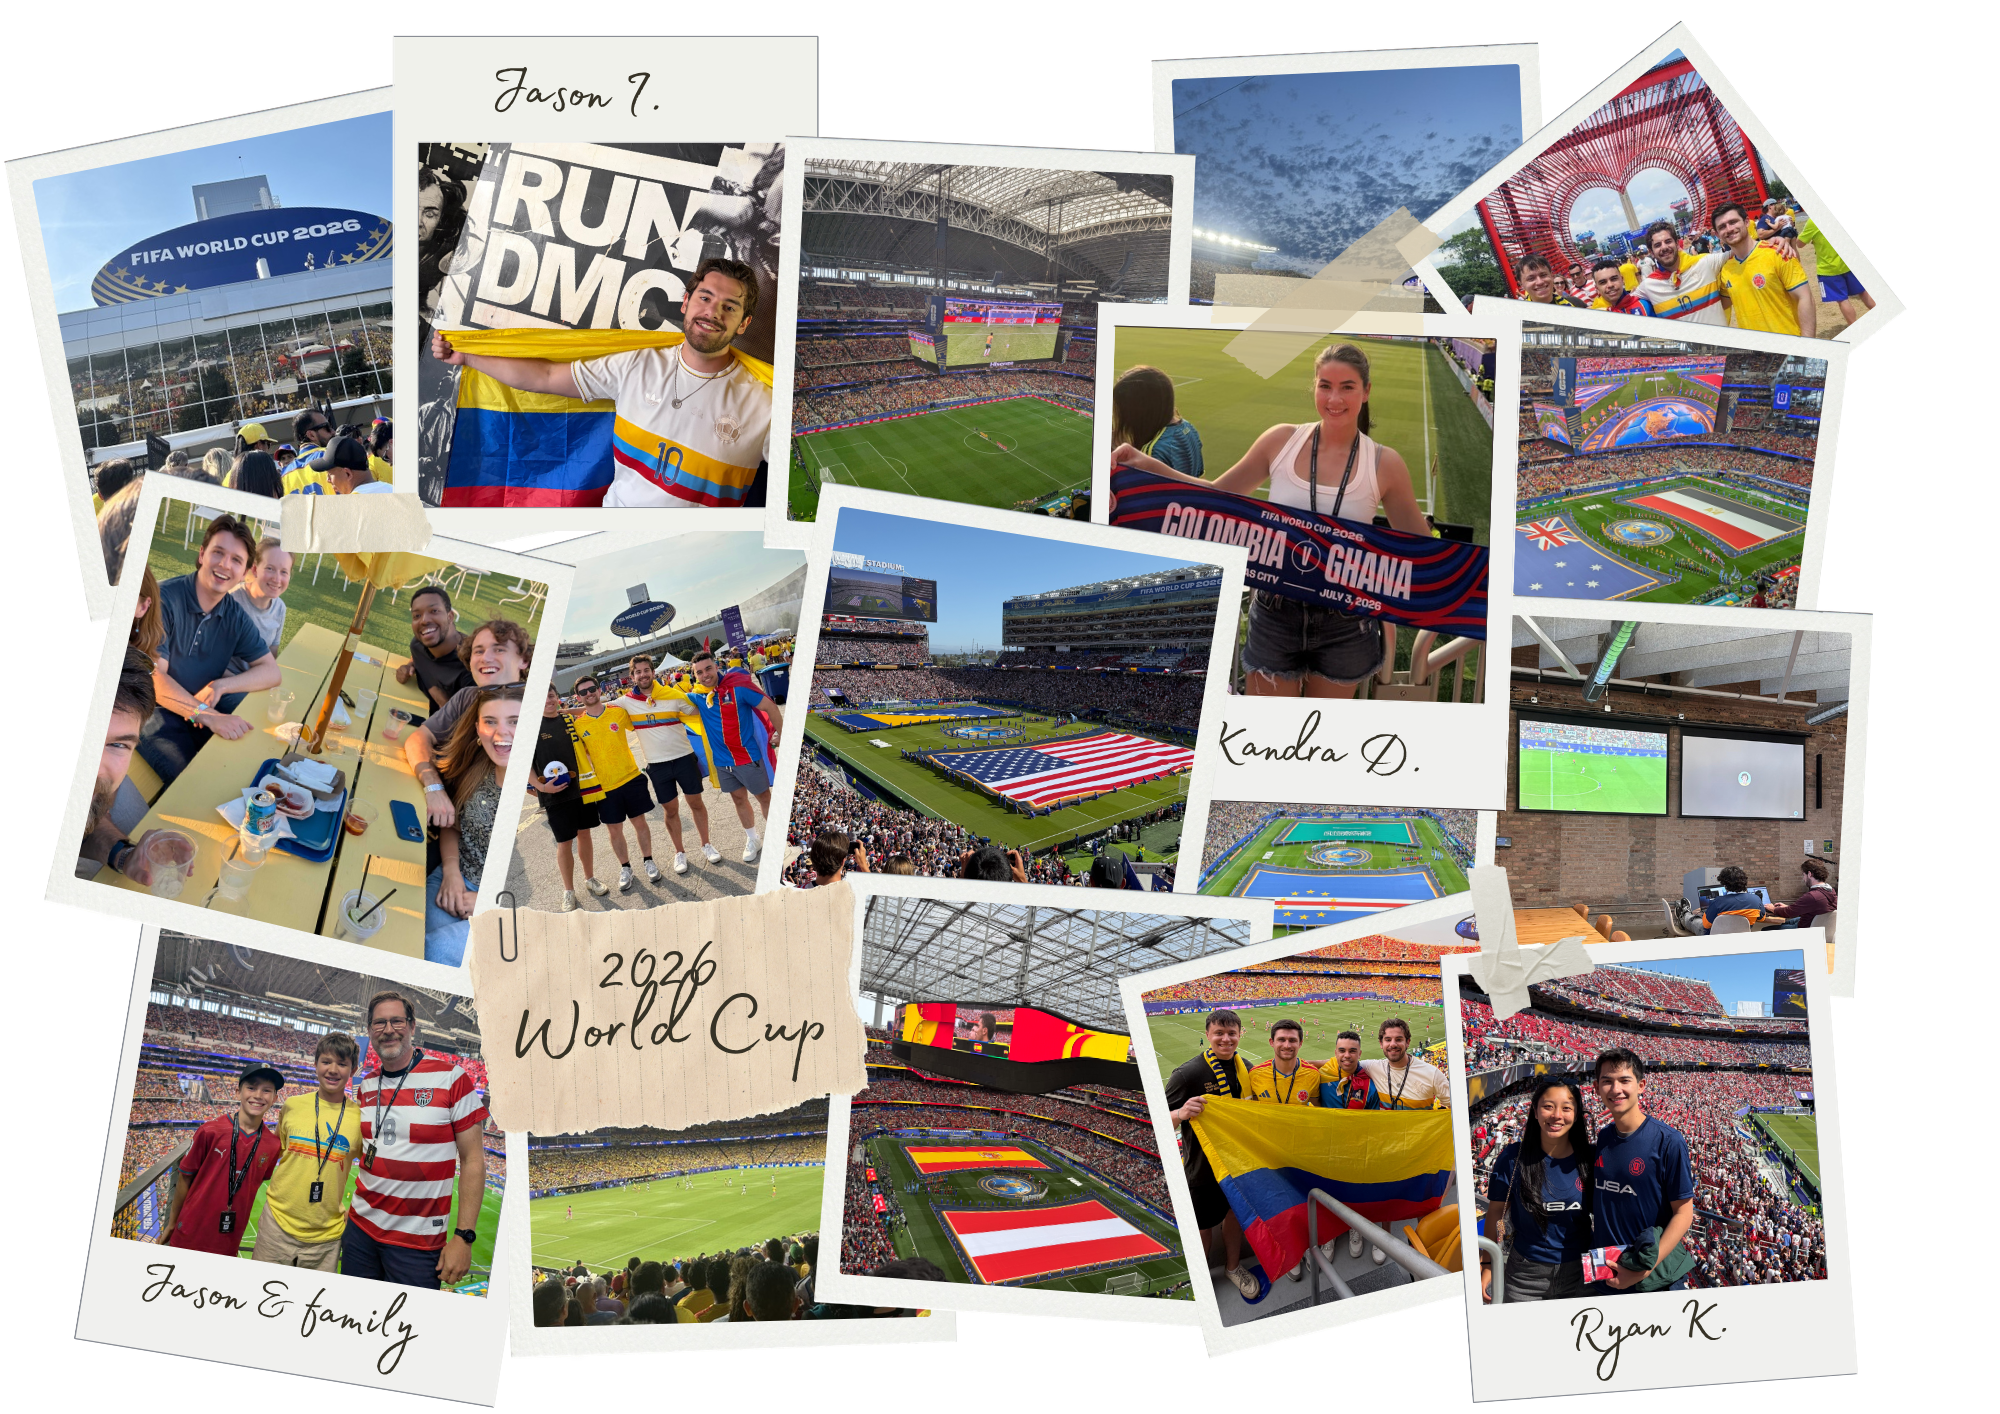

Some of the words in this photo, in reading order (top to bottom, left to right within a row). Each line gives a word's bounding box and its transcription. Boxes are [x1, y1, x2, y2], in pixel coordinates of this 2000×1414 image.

[492, 152, 712, 272] RUN
[131, 248, 174, 267] FIFA
[176, 236, 248, 259] WORLD
[250, 230, 290, 248] CUP
[292, 218, 362, 241] 2026
[476, 230, 686, 333] DMC
[1677, 295, 1693, 313] 10
[654, 441, 684, 487] 10
[1261, 510, 1280, 523] FIFA
[1280, 514, 1312, 531] WORLD
[1313, 522, 1332, 535] CUP
[1332, 527, 1363, 542] 2026
[1160, 502, 1288, 569] COLOMBIA
[1301, 545, 1310, 567] V
[1325, 543, 1413, 601] GHANA
[865, 560, 902, 571] STADIUM
[1140, 586, 1157, 595] FIFA
[1157, 583, 1180, 595] WORLD
[1180, 581, 1195, 590] CUP
[1257, 570, 1280, 585] CITY
[1319, 588, 1343, 603] JULY
[1343, 593, 1354, 607] 3,
[1355, 597, 1382, 612] 2026
[625, 612, 641, 620] WORLD
[649, 604, 665, 613] 2026
[646, 713, 657, 726] 10
[383, 1118, 396, 1146] 8
[1595, 1178, 1638, 1197] USA
[143, 1200, 153, 1217] WORLD
[1542, 1201, 1582, 1212] SA
[143, 1217, 153, 1230] FIFA
